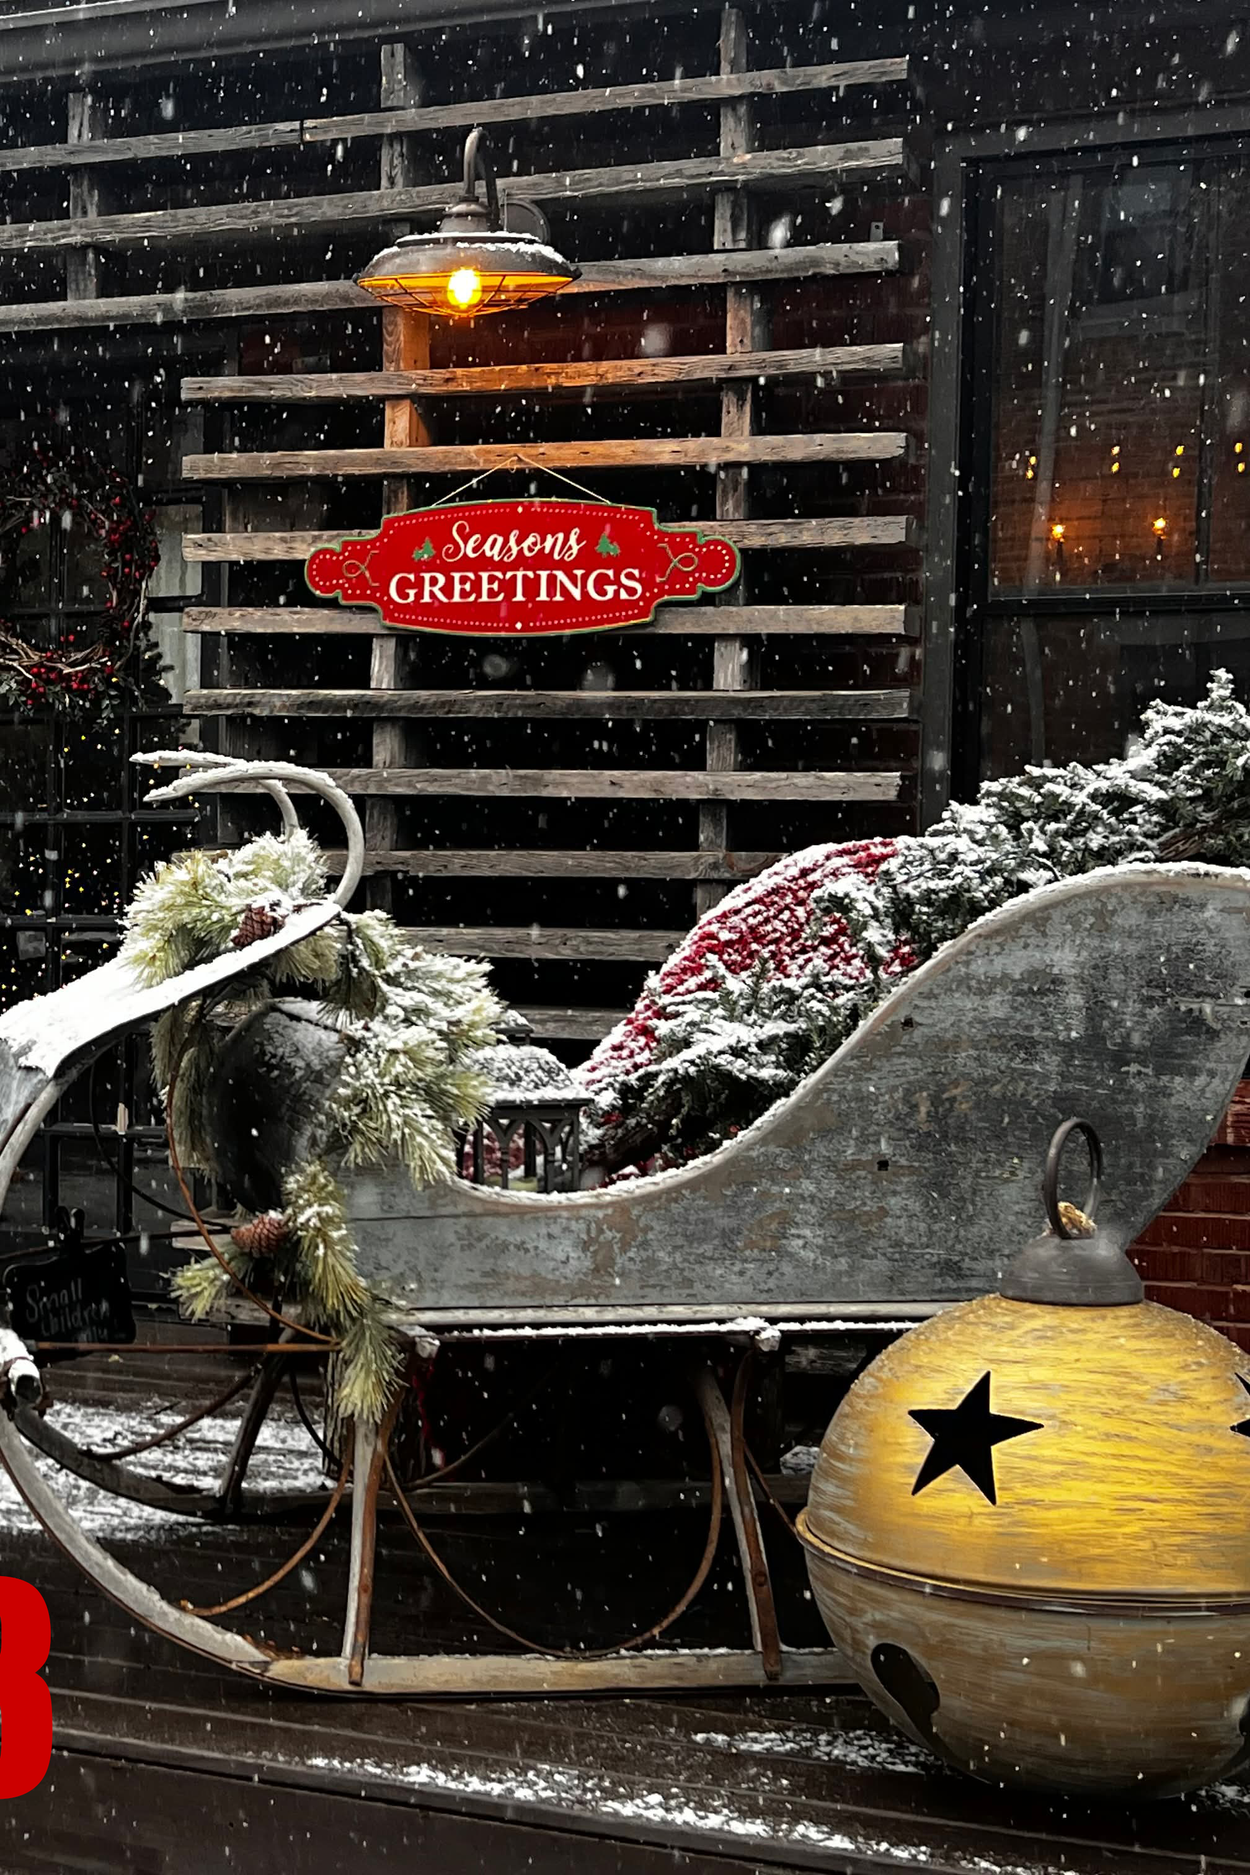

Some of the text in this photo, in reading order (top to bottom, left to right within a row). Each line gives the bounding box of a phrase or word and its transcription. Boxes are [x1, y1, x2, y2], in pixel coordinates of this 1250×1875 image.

[442, 521, 586, 562] Seasons
[389, 568, 643, 604] GREETINGS
[26, 1278, 82, 1323] Small
